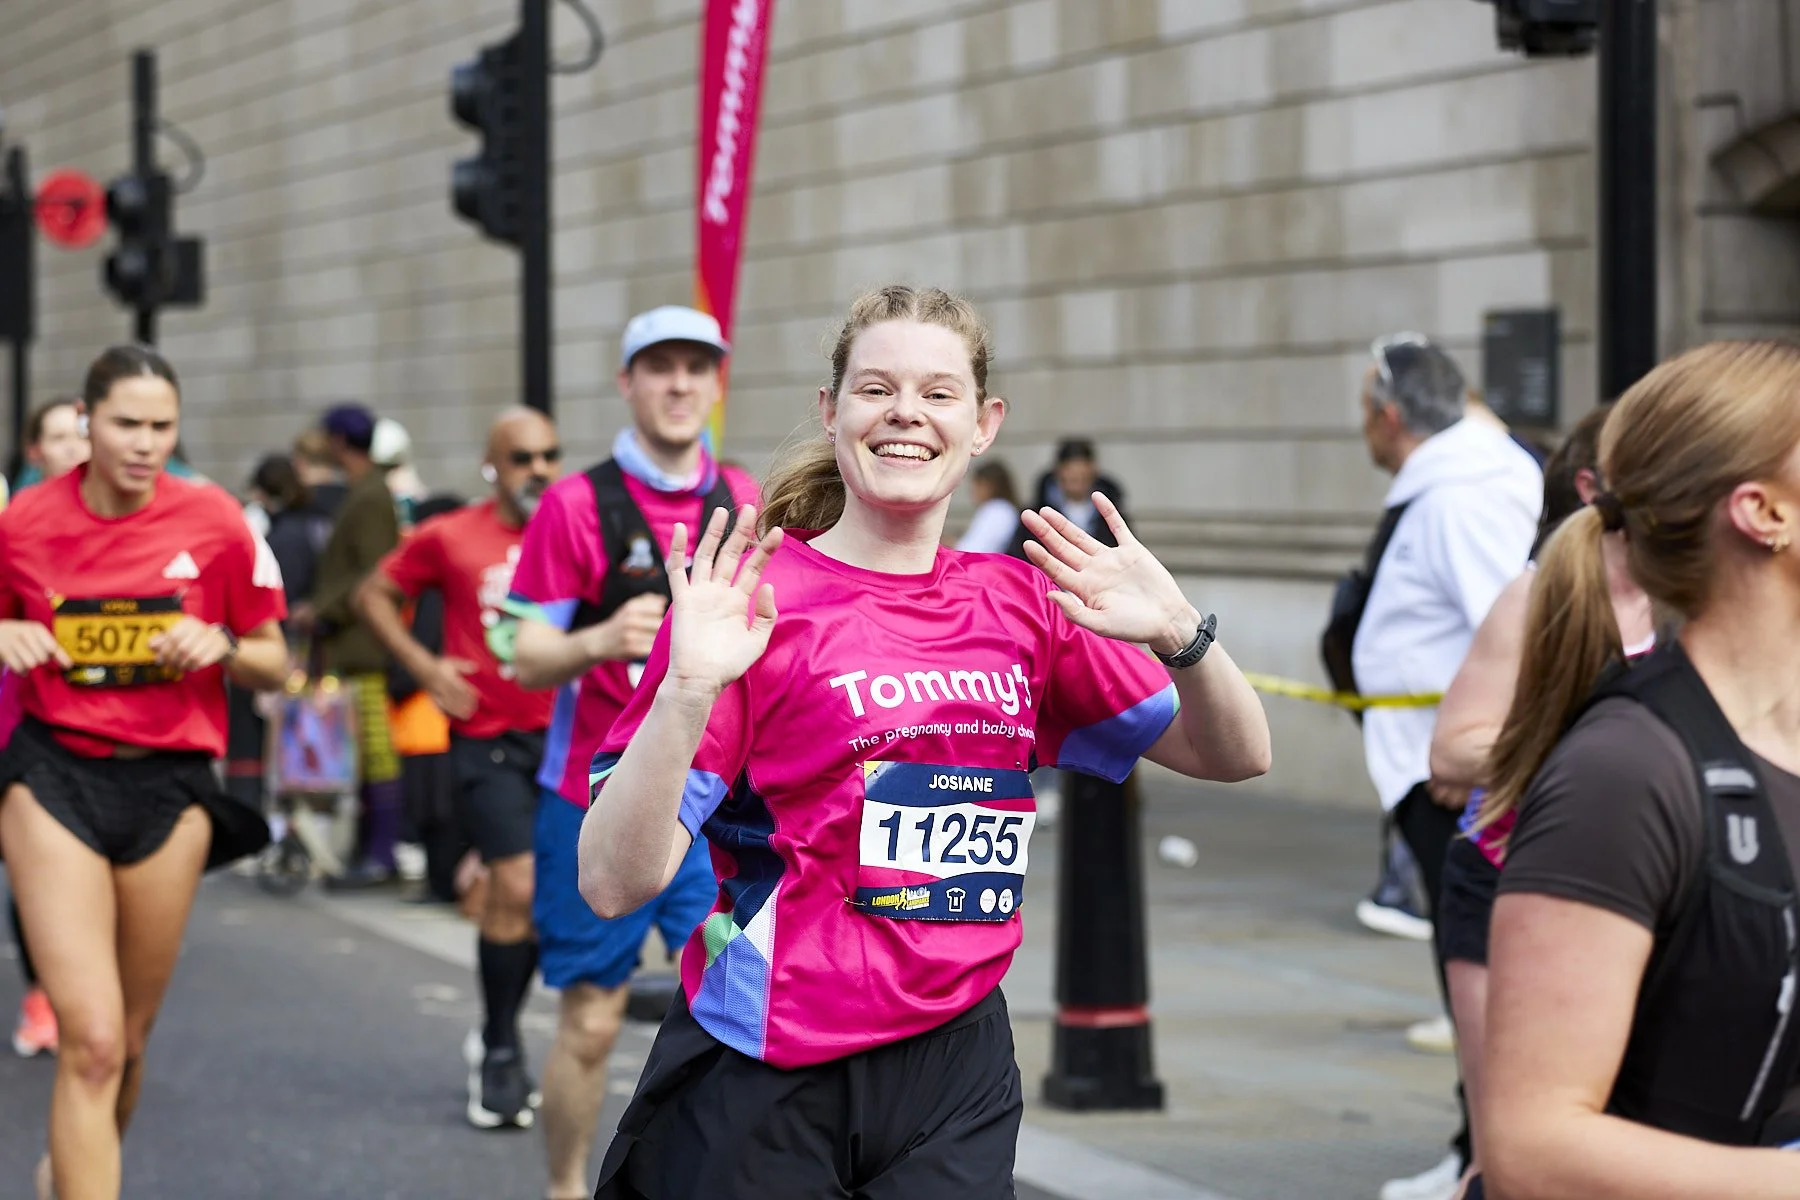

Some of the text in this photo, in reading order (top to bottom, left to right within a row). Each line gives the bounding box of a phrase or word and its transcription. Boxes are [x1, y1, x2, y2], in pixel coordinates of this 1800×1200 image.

[829, 664, 1032, 716] Tommy's
[848, 733, 880, 752] The
[885, 721, 952, 744] pregnancy
[955, 719, 979, 735] and
[982, 719, 1016, 739] baby
[928, 774, 994, 793] JOSIANE
[878, 810, 1024, 866] 11255
[871, 893, 901, 907] LONDON
